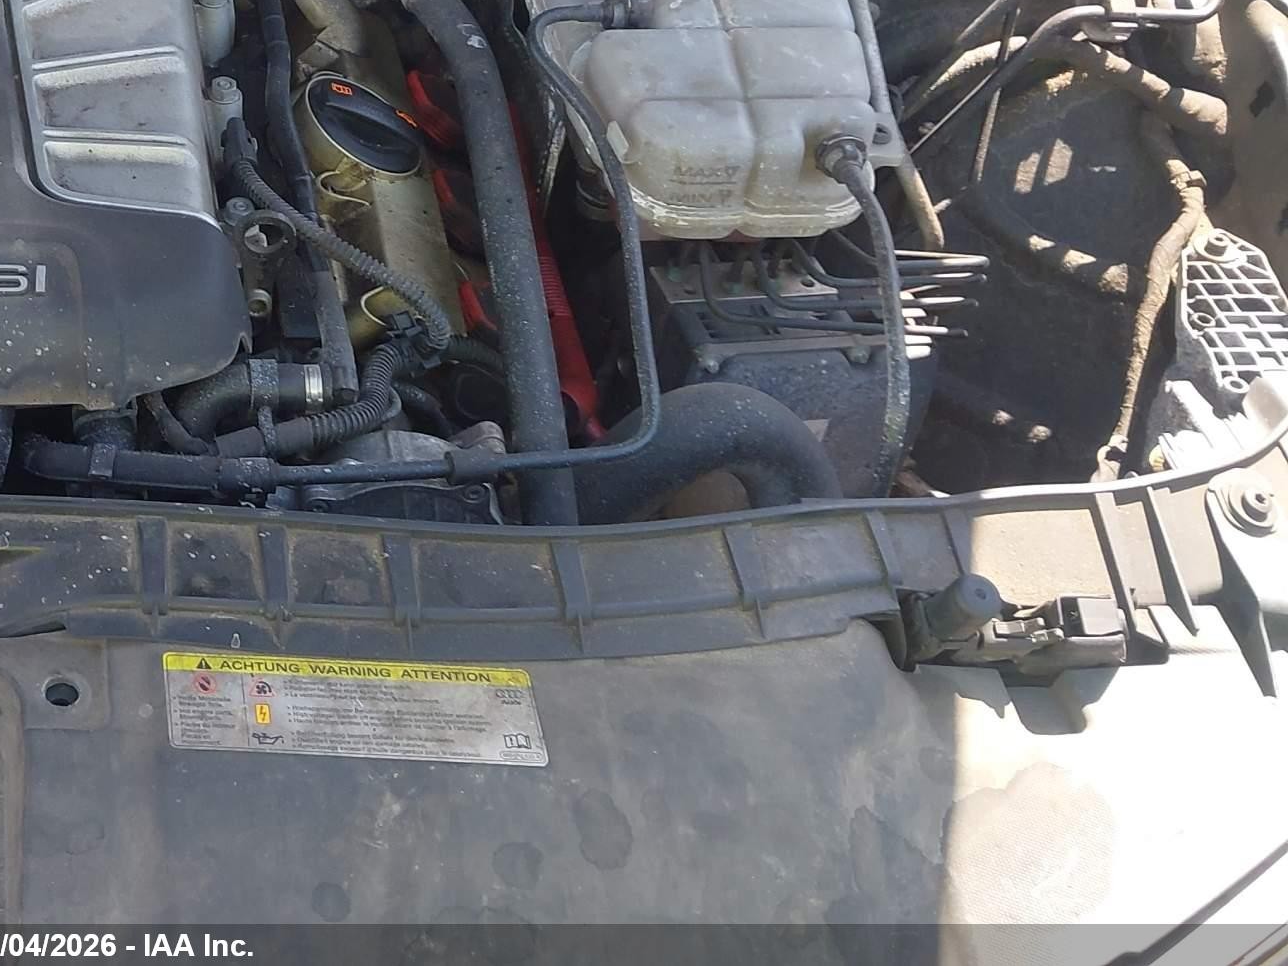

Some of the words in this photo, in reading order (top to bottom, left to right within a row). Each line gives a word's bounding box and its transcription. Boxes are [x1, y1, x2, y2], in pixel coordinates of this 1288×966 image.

[219, 660, 301, 673] ACHTUNG
[309, 664, 392, 677] WARNING
[400, 668, 492, 683] ATTENTION
